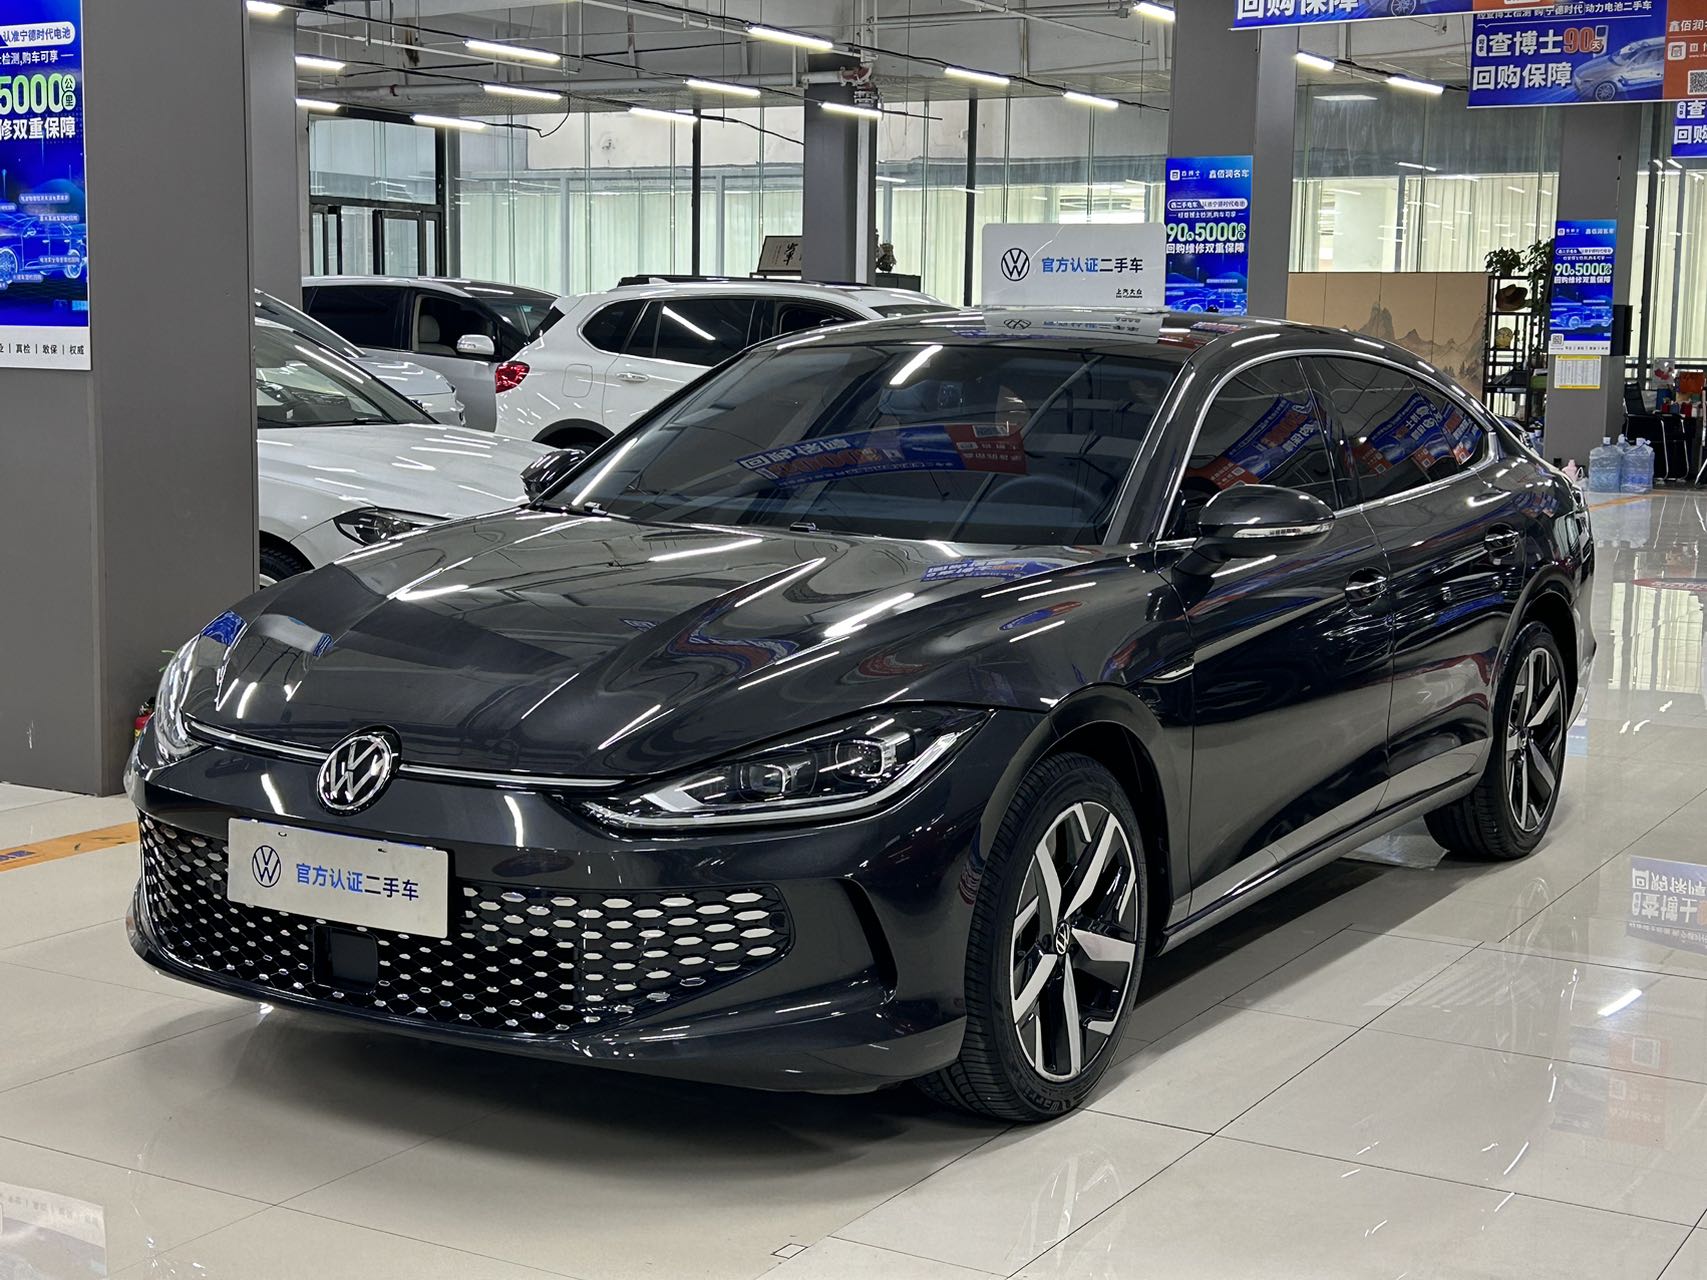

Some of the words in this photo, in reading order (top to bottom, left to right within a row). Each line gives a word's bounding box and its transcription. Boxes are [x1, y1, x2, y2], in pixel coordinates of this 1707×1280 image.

[1585, 1, 1652, 13] 动力电池二手车
[1669, 20, 1707, 32] 鑫佰润
[3, 27, 71, 42] 认准宁德时代电池
[0, 50, 58, 66] 检测,购车可享
[1473, 62, 1572, 90] 回购保障
[0, 116, 76, 140] 修双重保障
[1042, 257, 1143, 273] 官方认证二手车
[296, 863, 419, 901] 官方认证二手车
